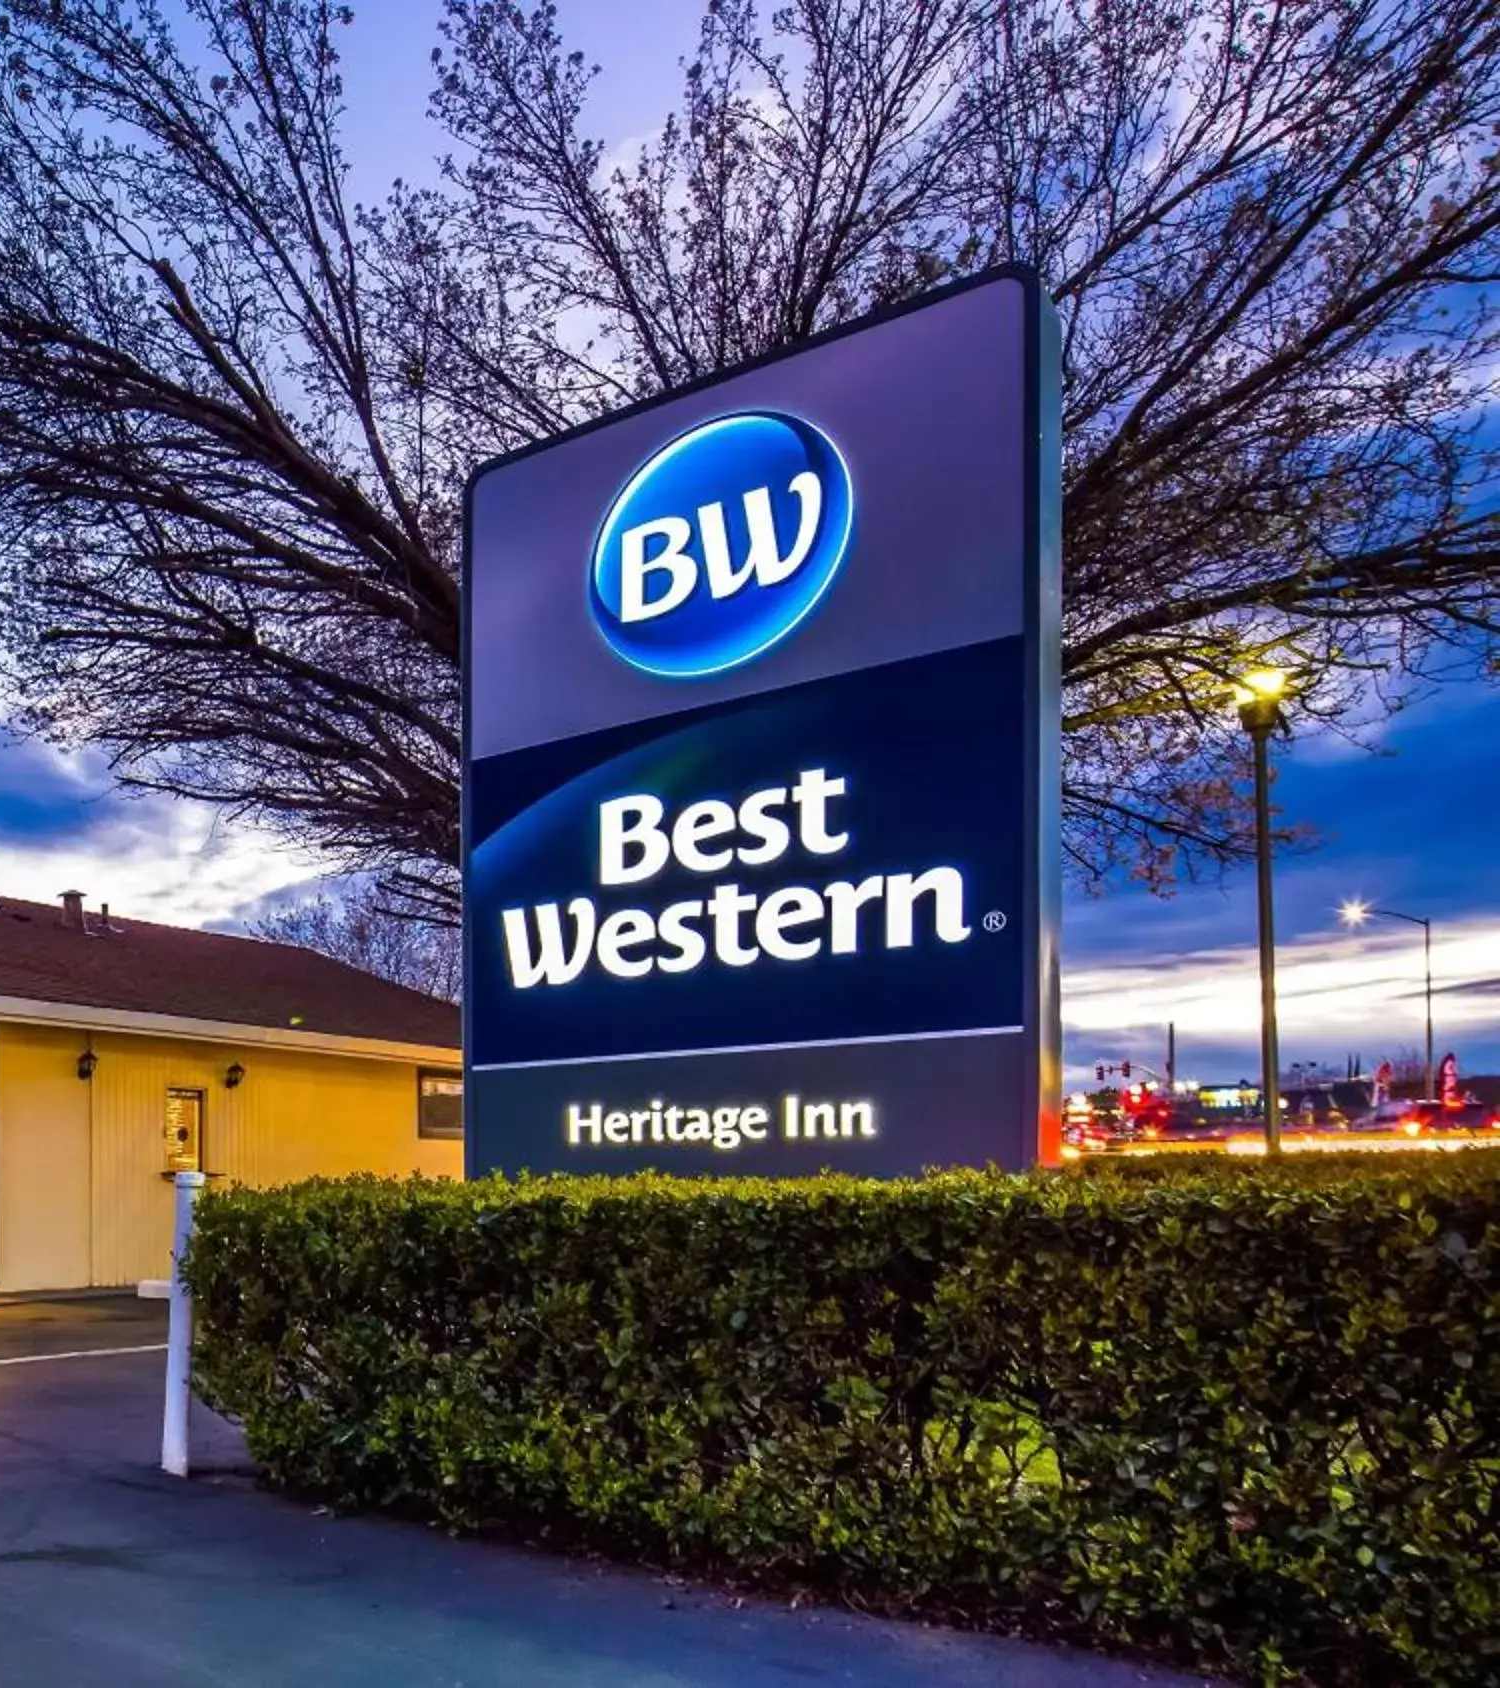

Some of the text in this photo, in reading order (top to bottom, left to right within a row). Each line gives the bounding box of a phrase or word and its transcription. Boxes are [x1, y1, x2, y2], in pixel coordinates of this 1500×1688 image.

[620, 471, 822, 623] BW
[599, 768, 849, 886] Best
[502, 866, 972, 990] Western
[566, 1094, 878, 1150] Heritage Inn
